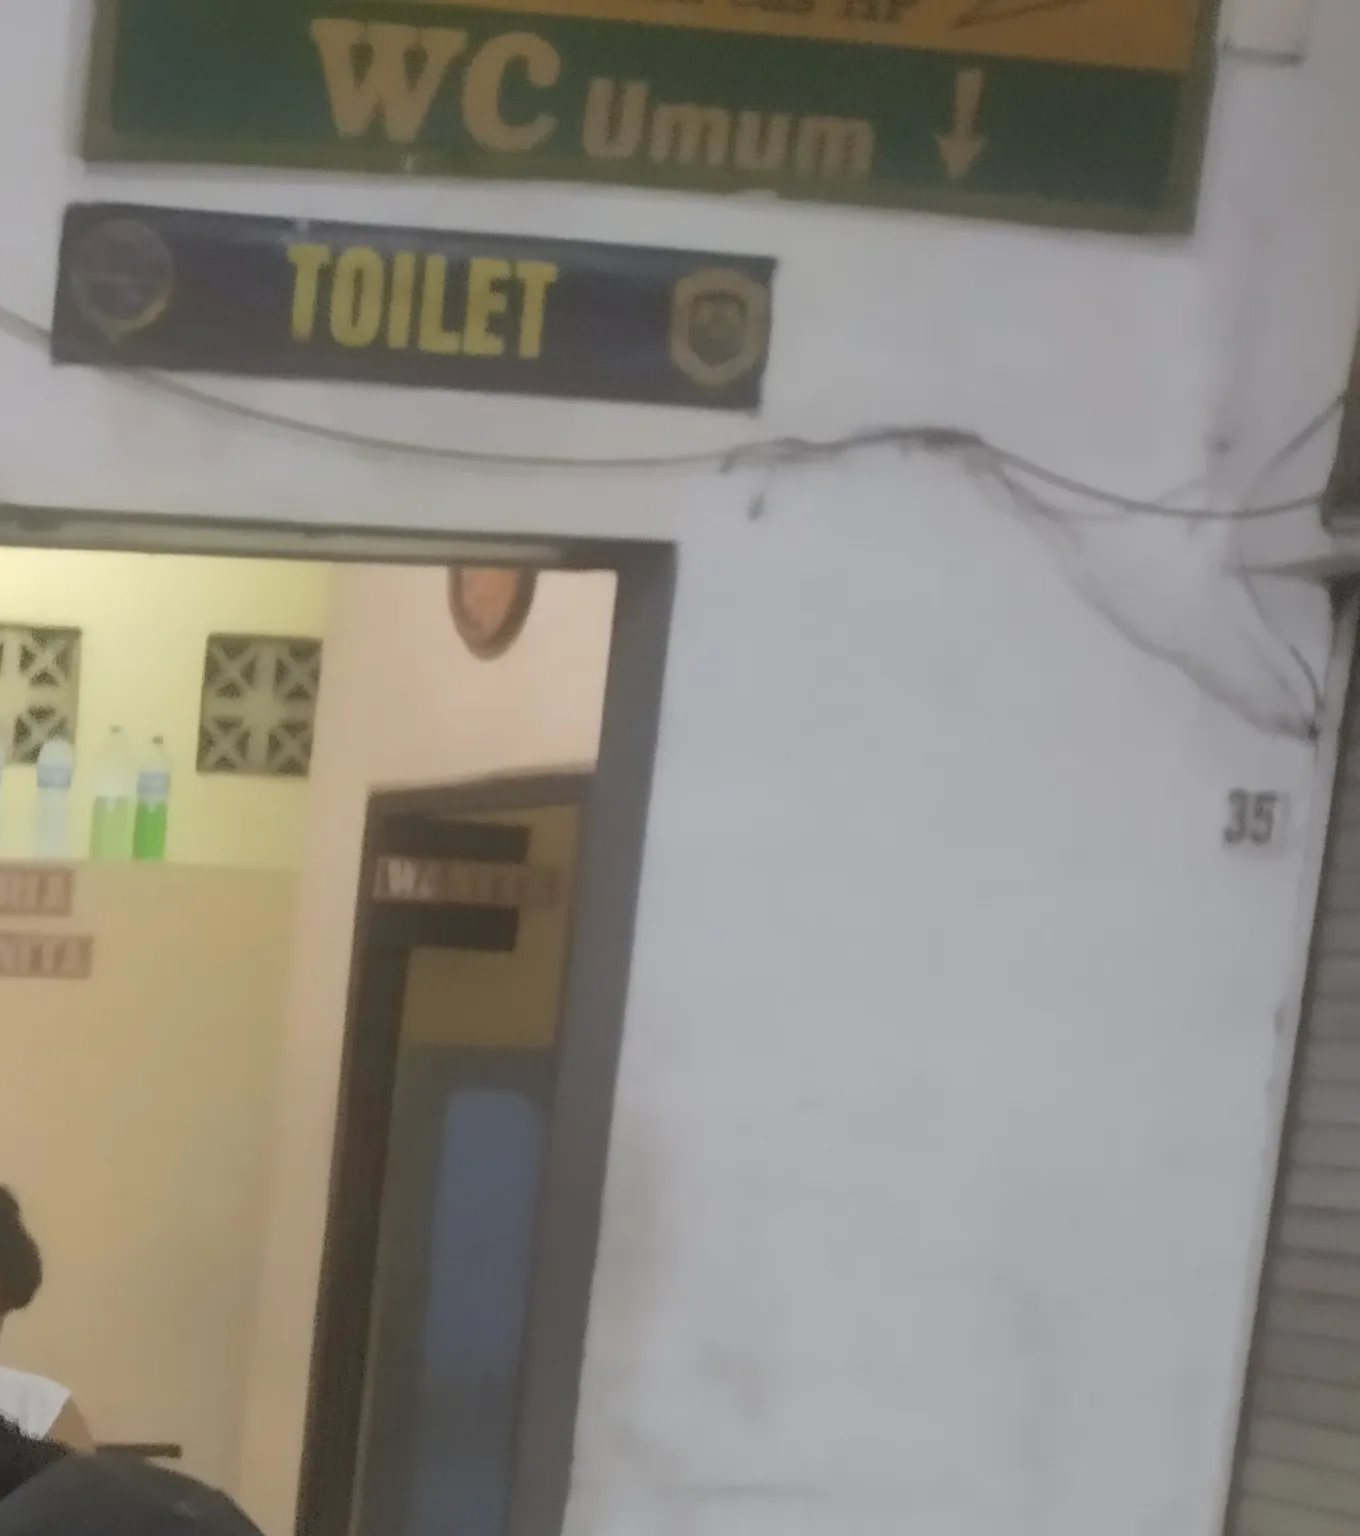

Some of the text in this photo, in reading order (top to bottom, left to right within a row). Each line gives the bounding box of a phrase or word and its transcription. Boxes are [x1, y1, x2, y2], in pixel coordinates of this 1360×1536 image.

[309, 18, 874, 179] WC Umum
[286, 242, 560, 360] TOILET
[1224, 787, 1278, 847] 35
